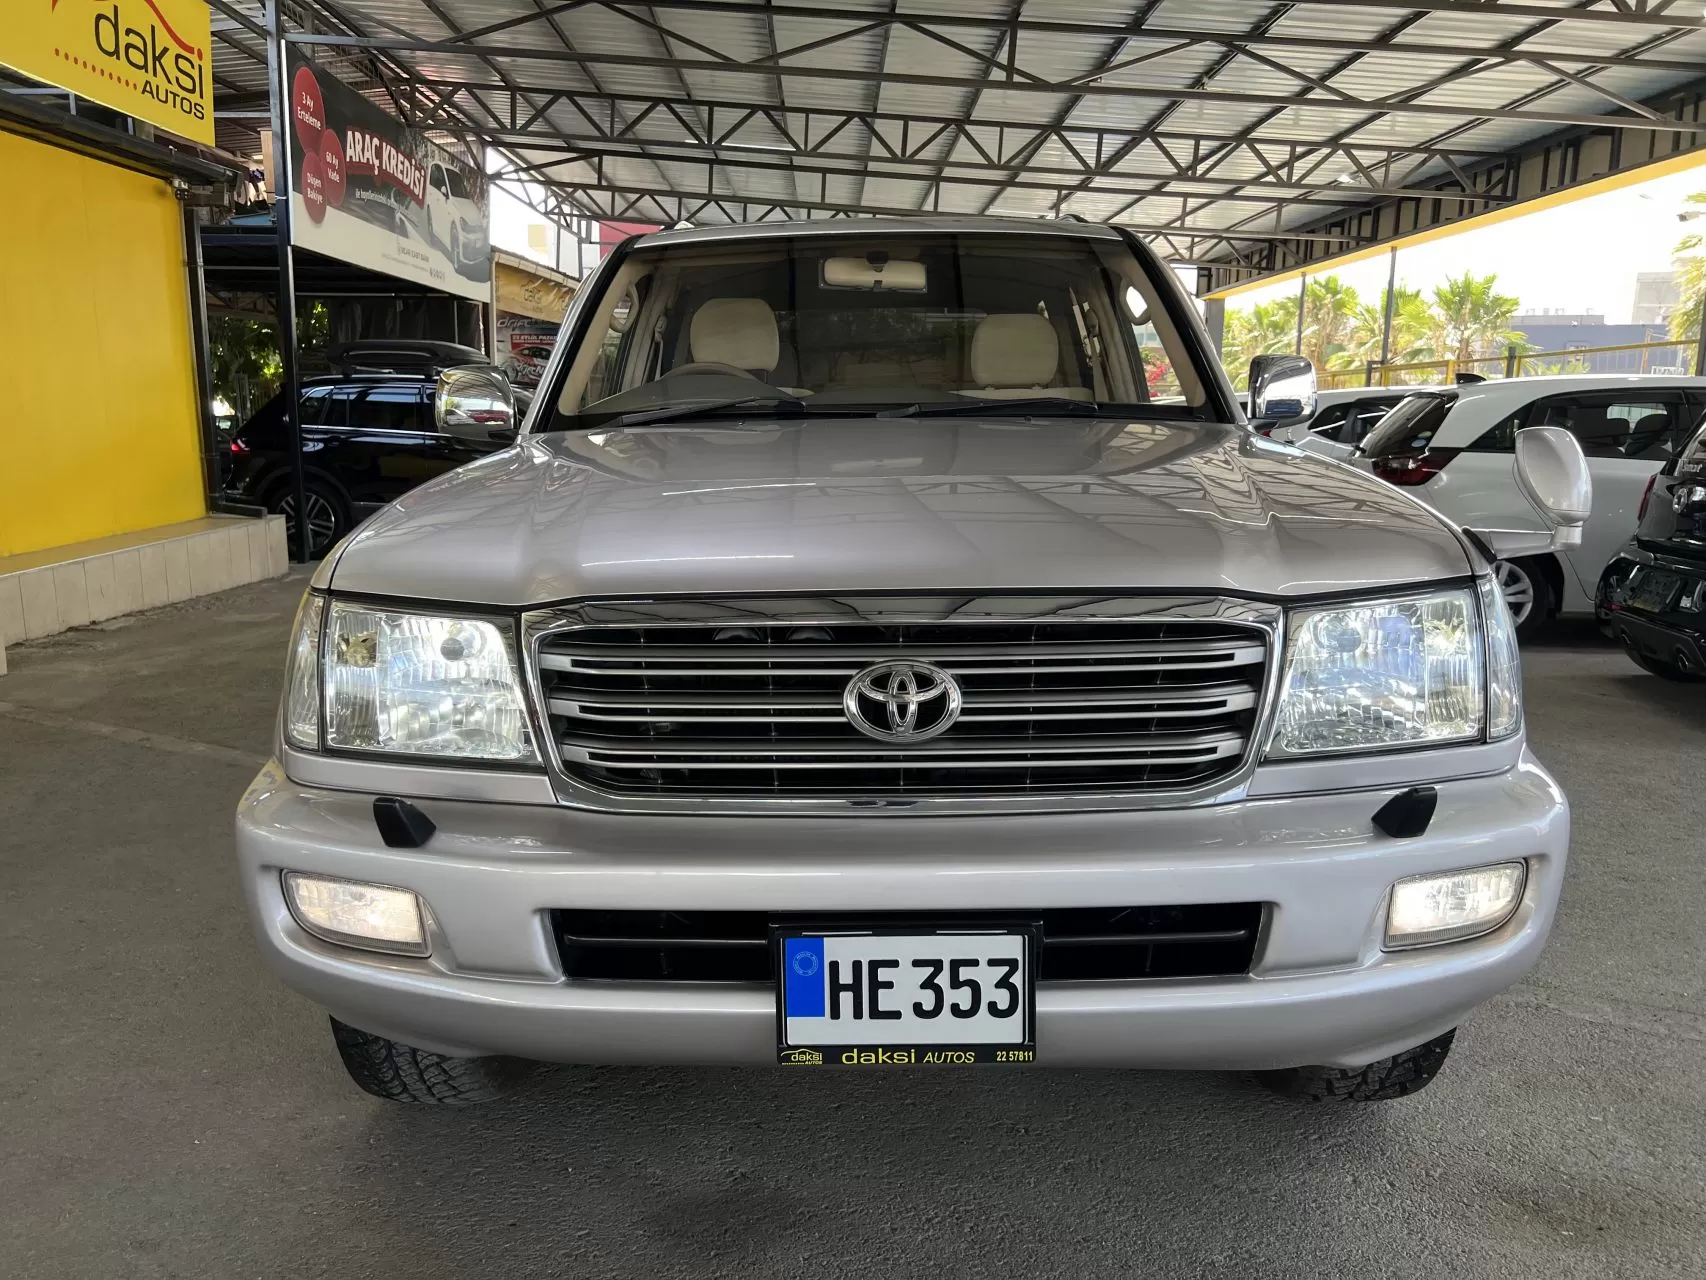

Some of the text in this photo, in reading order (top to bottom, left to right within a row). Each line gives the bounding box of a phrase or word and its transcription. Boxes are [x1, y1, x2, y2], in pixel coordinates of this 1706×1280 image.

[94, 4, 204, 100] daksi
[141, 80, 205, 120] AUTOS
[302, 92, 314, 111] 3 Ay
[297, 106, 321, 131] Erteleme
[332, 155, 339, 169] Ay
[346, 131, 426, 200] ARAÇ KREDİSİ
[307, 172, 322, 189] Düşen
[327, 167, 340, 183] Vade
[307, 188, 323, 205] Bakiye
[828, 959, 903, 1020] HE
[911, 957, 1020, 1020] 353
[791, 1052, 823, 1062] daksi
[841, 1048, 1033, 1065] daksi AUTOS 22 57811
